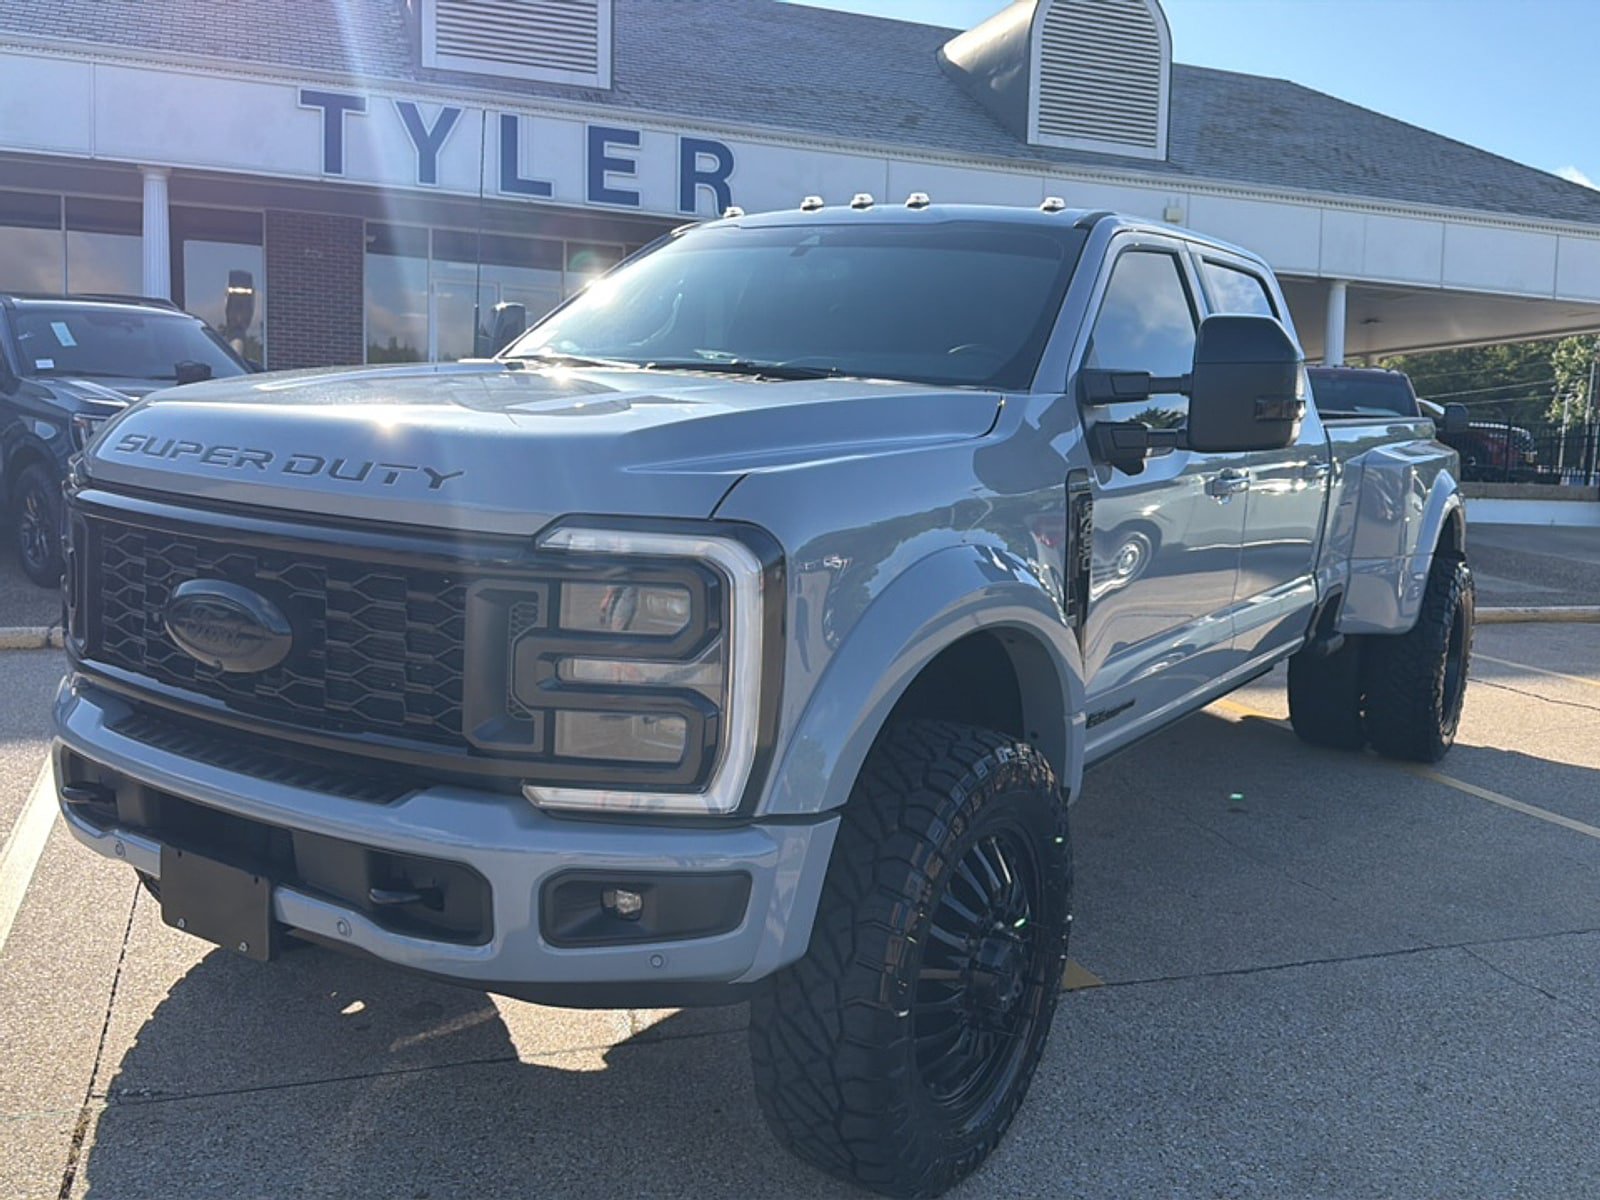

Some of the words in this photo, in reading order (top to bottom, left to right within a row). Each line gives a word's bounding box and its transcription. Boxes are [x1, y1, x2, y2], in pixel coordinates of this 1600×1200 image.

[299, 89, 735, 215] TYLER
[115, 433, 274, 471] SUPER
[281, 453, 465, 490] DUTY
